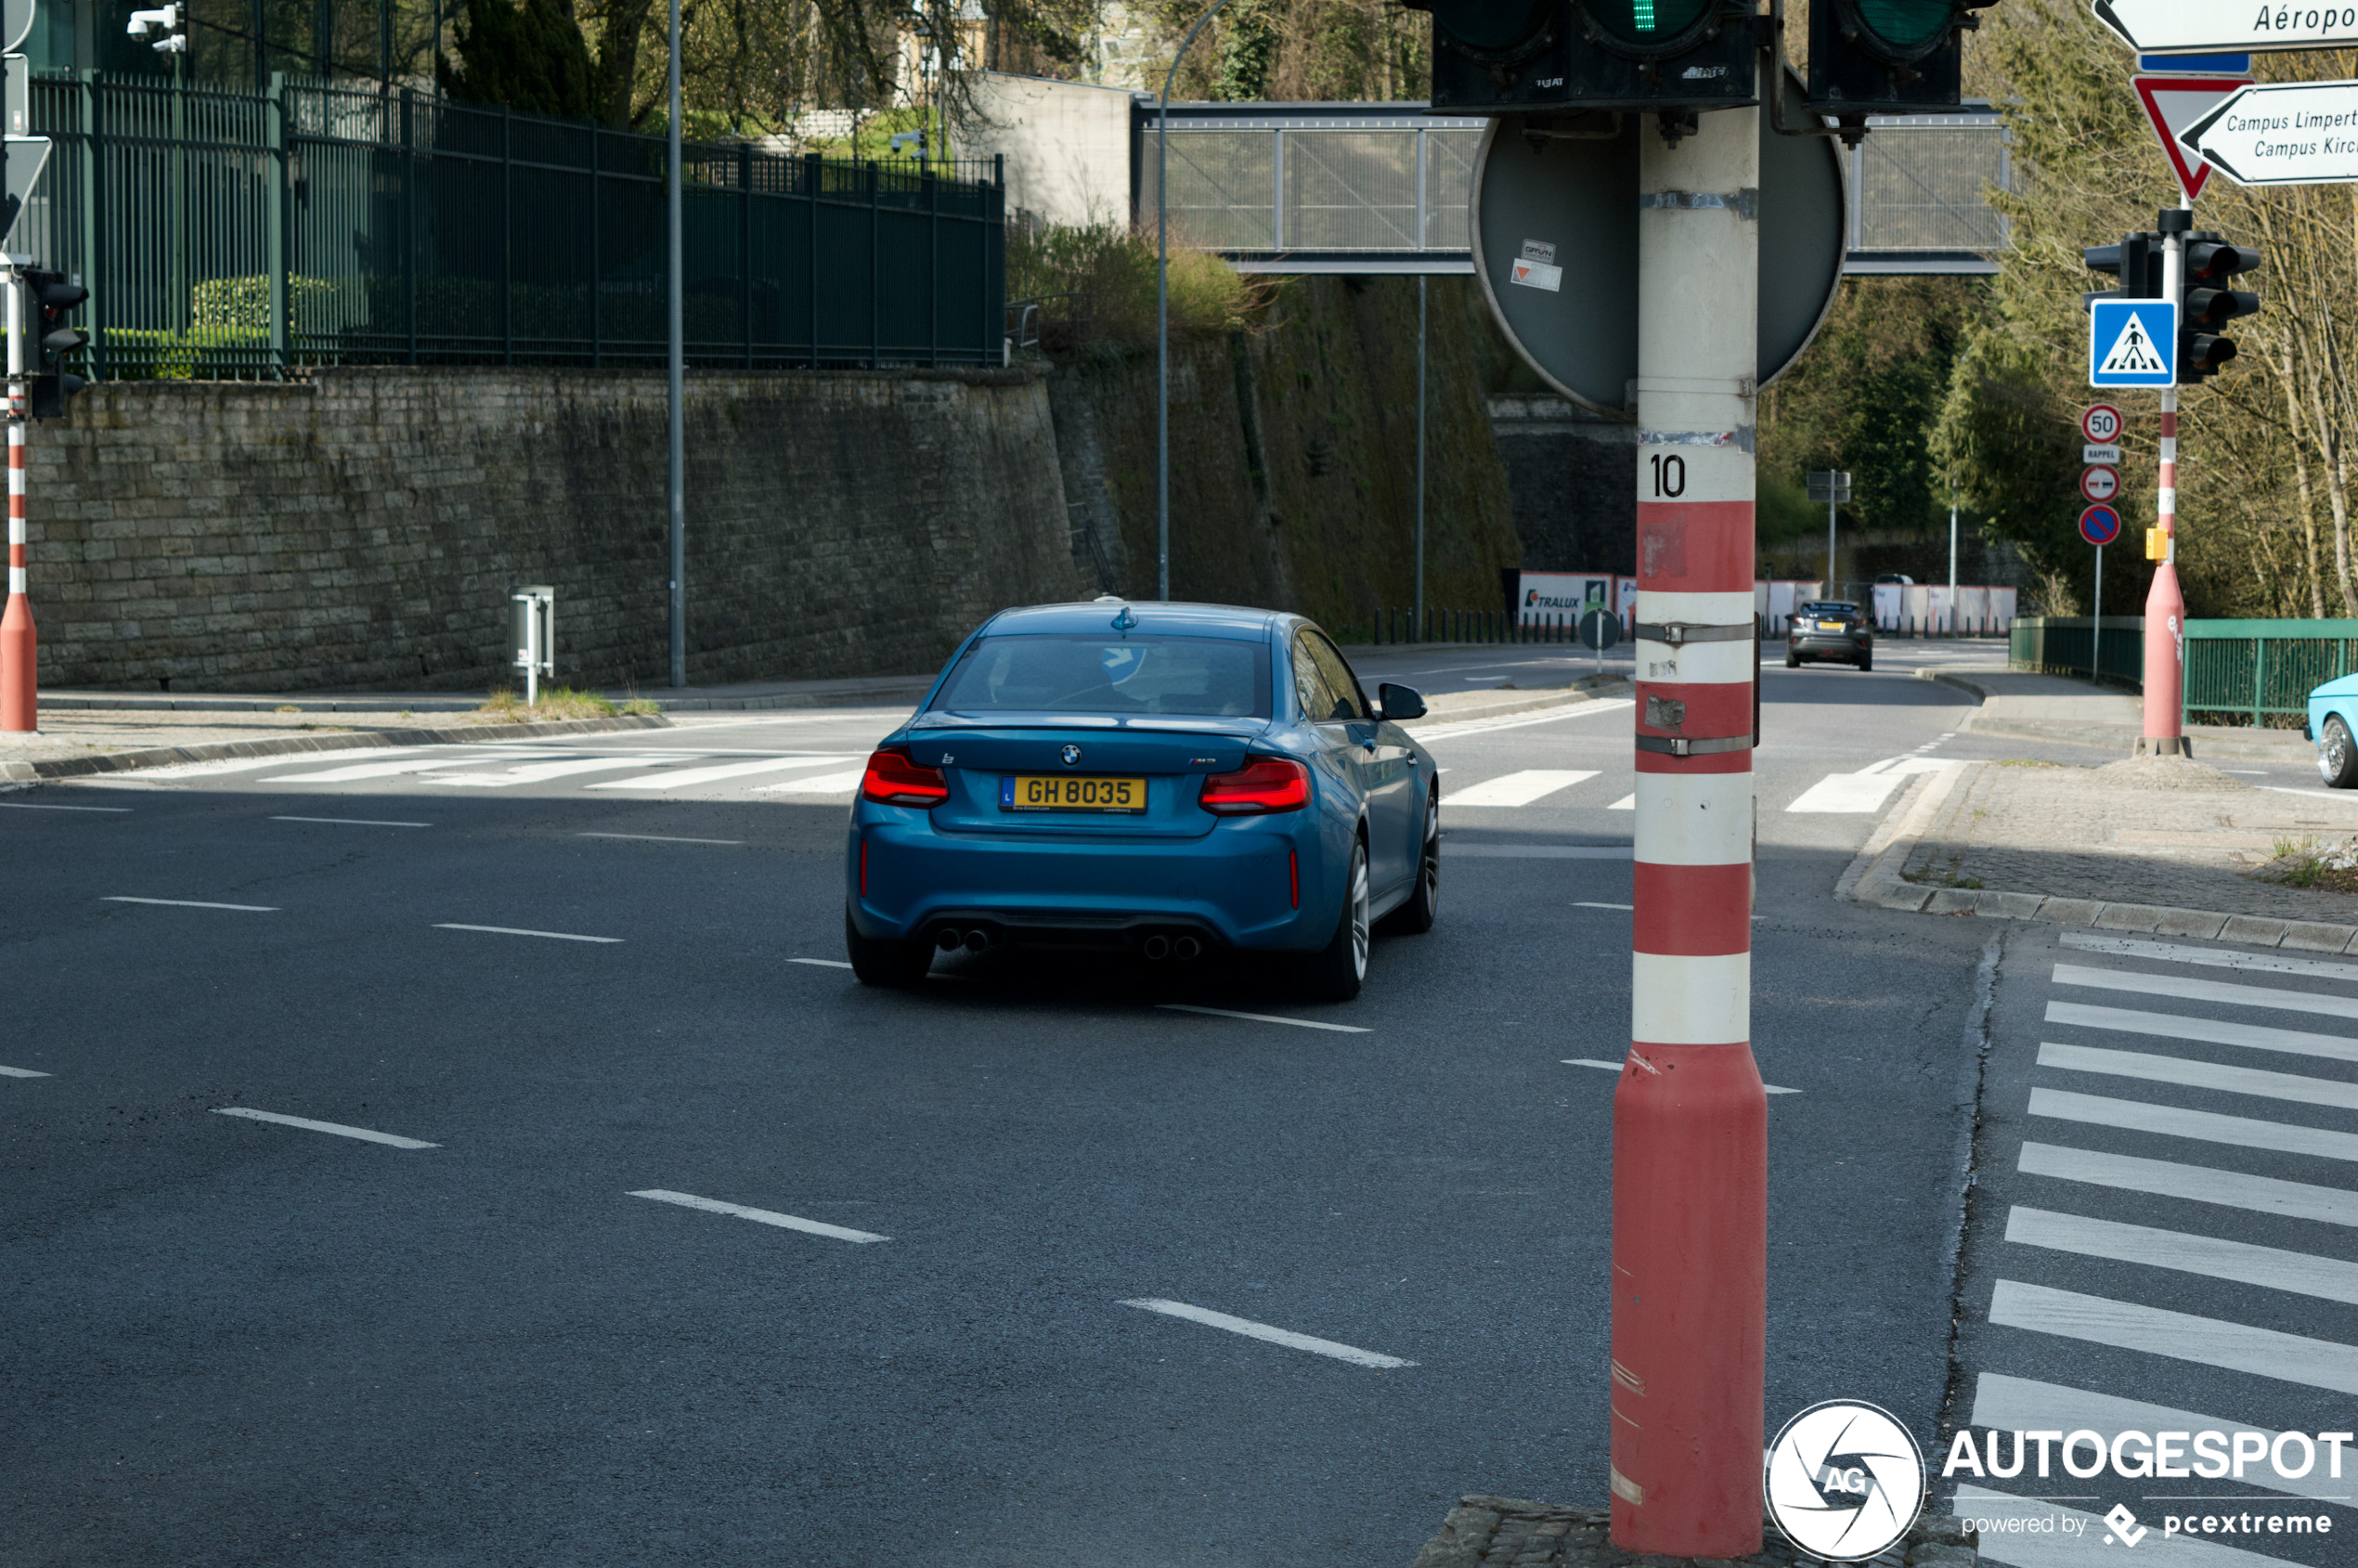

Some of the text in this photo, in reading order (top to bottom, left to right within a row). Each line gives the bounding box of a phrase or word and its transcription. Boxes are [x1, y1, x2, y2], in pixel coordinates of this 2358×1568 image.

[2253, 4, 2356, 35] Aéropo
[2227, 109, 2358, 135] Campus Limpert
[2254, 140, 2317, 160] Campus
[2092, 415, 2114, 434] 50
[2088, 449, 2116, 460] RAPPEL
[1650, 453, 1686, 499] 10
[1004, 780, 1132, 805] L GH 8035
